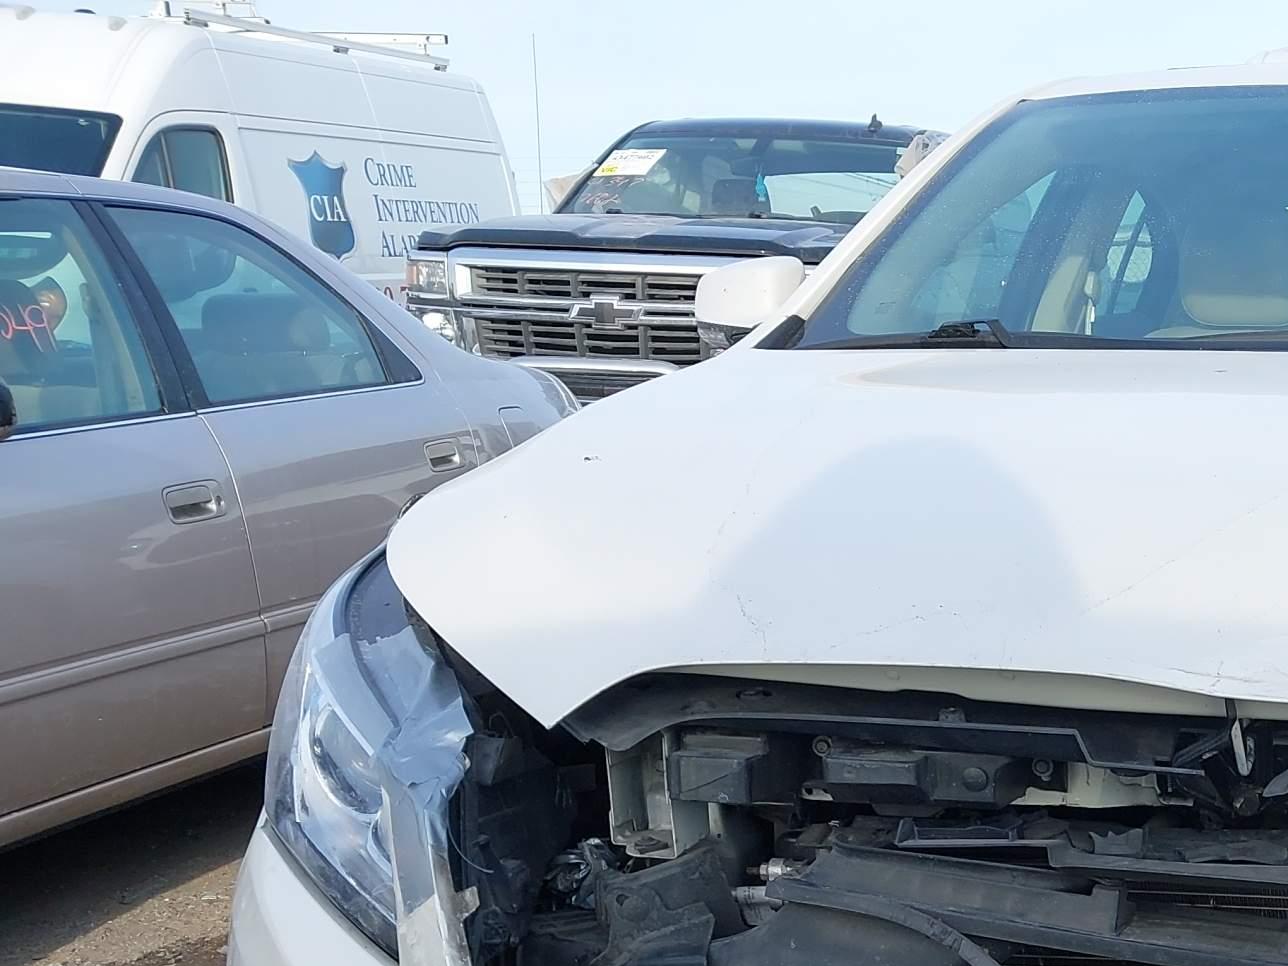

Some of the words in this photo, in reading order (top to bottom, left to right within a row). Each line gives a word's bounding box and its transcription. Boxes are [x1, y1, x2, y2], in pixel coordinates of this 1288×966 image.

[363, 157, 417, 188] CRIME
[310, 194, 347, 222] CIA
[372, 194, 480, 224] INTERVENTION
